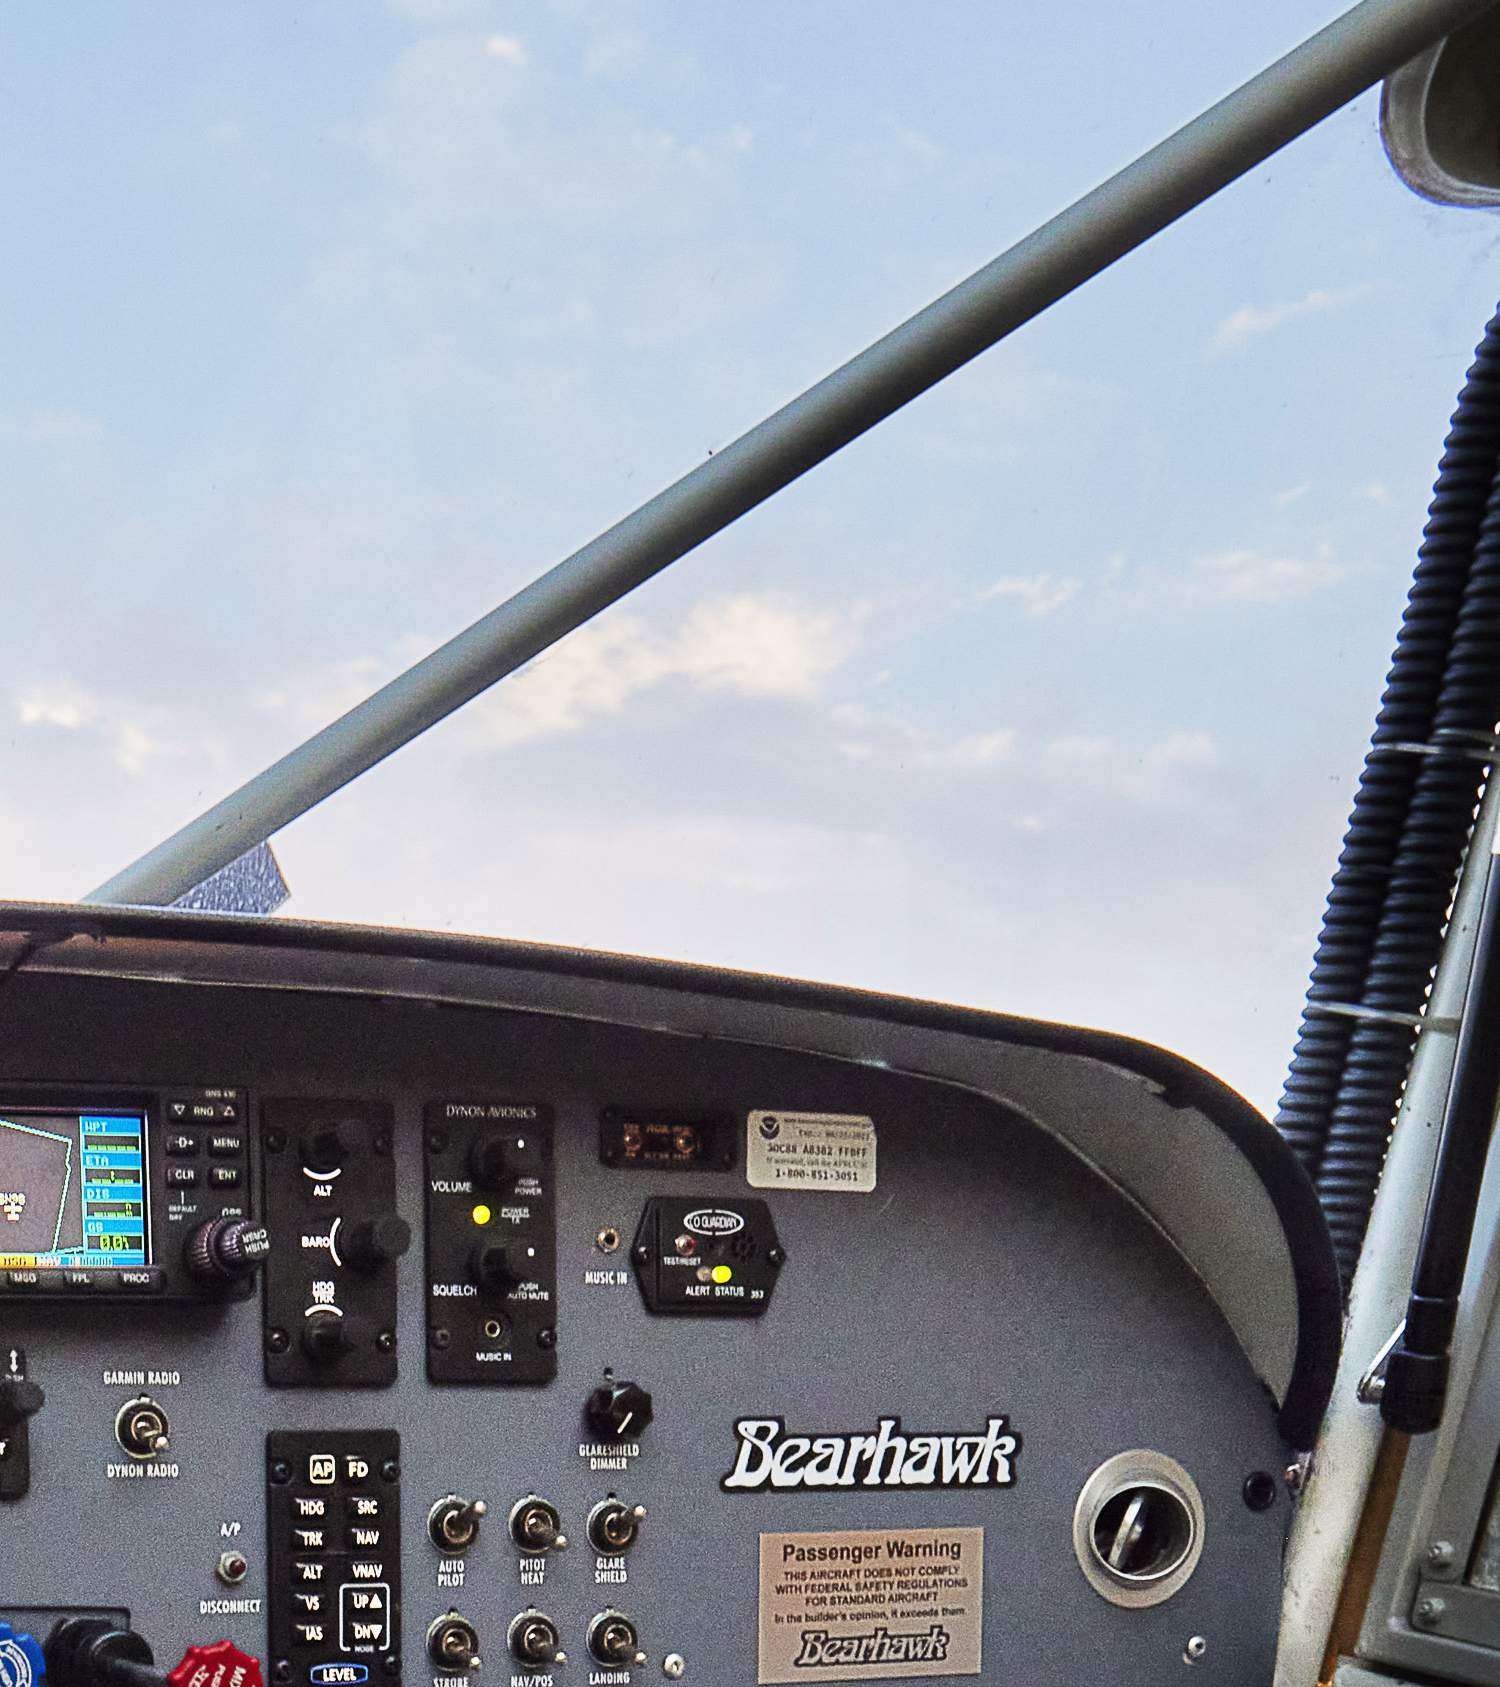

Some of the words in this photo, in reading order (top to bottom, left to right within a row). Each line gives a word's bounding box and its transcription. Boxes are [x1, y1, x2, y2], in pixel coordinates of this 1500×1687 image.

[447, 1105, 484, 1117] DYNON
[488, 1106, 536, 1118] AVIONICS
[214, 1138, 240, 1148] MENU
[175, 1170, 194, 1180] CLR
[218, 1170, 236, 1180] ENT
[313, 1186, 332, 1196] ALT
[432, 1181, 471, 1193] VOLUME
[302, 1236, 329, 1247] BARO
[585, 1272, 614, 1284] MUSIC
[617, 1272, 627, 1284] IN
[433, 1285, 477, 1296] SQUELCH
[686, 1286, 710, 1296] ALERT
[715, 1287, 744, 1296] STATUS
[104, 1372, 144, 1384] GARMIN
[148, 1372, 180, 1384] RADIO
[579, 1444, 639, 1457] GLARESHIELD
[725, 1419, 1015, 1487] Bearhawk
[313, 1464, 332, 1476] AP
[349, 1463, 368, 1477] FD
[591, 1458, 627, 1470] DIMMER
[107, 1464, 143, 1477] DYNON
[147, 1464, 178, 1477] RADIO
[300, 1501, 324, 1515] HDG
[358, 1501, 377, 1514] SRC
[221, 1522, 241, 1537] A/P
[303, 1532, 323, 1545] TRK
[356, 1532, 379, 1544] NAV
[783, 1544, 881, 1564] Passenger
[887, 1540, 961, 1560] Warning
[439, 1561, 464, 1572] AUTO
[520, 1559, 545, 1571] PITOT
[597, 1558, 624, 1569] GLARE
[303, 1565, 323, 1579] ALT
[353, 1565, 382, 1577] VNAV
[595, 1570, 627, 1583] SHIELD
[785, 1572, 807, 1581] THIS
[809, 1569, 860, 1580] AIRCRAFT
[864, 1568, 892, 1578] DOES
[895, 1568, 915, 1577] NOT
[919, 1566, 959, 1576] COMPLY
[438, 1573, 464, 1586] PILOT
[521, 1573, 544, 1584] HEAT
[775, 1585, 801, 1594] WITH
[805, 1583, 851, 1593] FEDERAL
[856, 1582, 893, 1592] SAFETY
[897, 1579, 968, 1589] REGULATIONS
[305, 1597, 319, 1610] VS
[354, 1595, 368, 1608] UP
[805, 1597, 827, 1607] FOR
[830, 1595, 884, 1605] STANDARD
[888, 1592, 938, 1603] AIRCRAFT
[200, 1600, 260, 1614] DISCONNECT
[787, 1614, 802, 1622] the
[805, 1612, 846, 1622] builder's
[900, 1609, 939, 1618] exceeds
[306, 1627, 323, 1640] IAS
[355, 1626, 370, 1638] DN
[798, 1626, 946, 1665] Bearhawk
[323, 1669, 356, 1681] LEVEL
[589, 1673, 630, 1685] LANDING
[511, 1676, 553, 1687] NAV/POS
